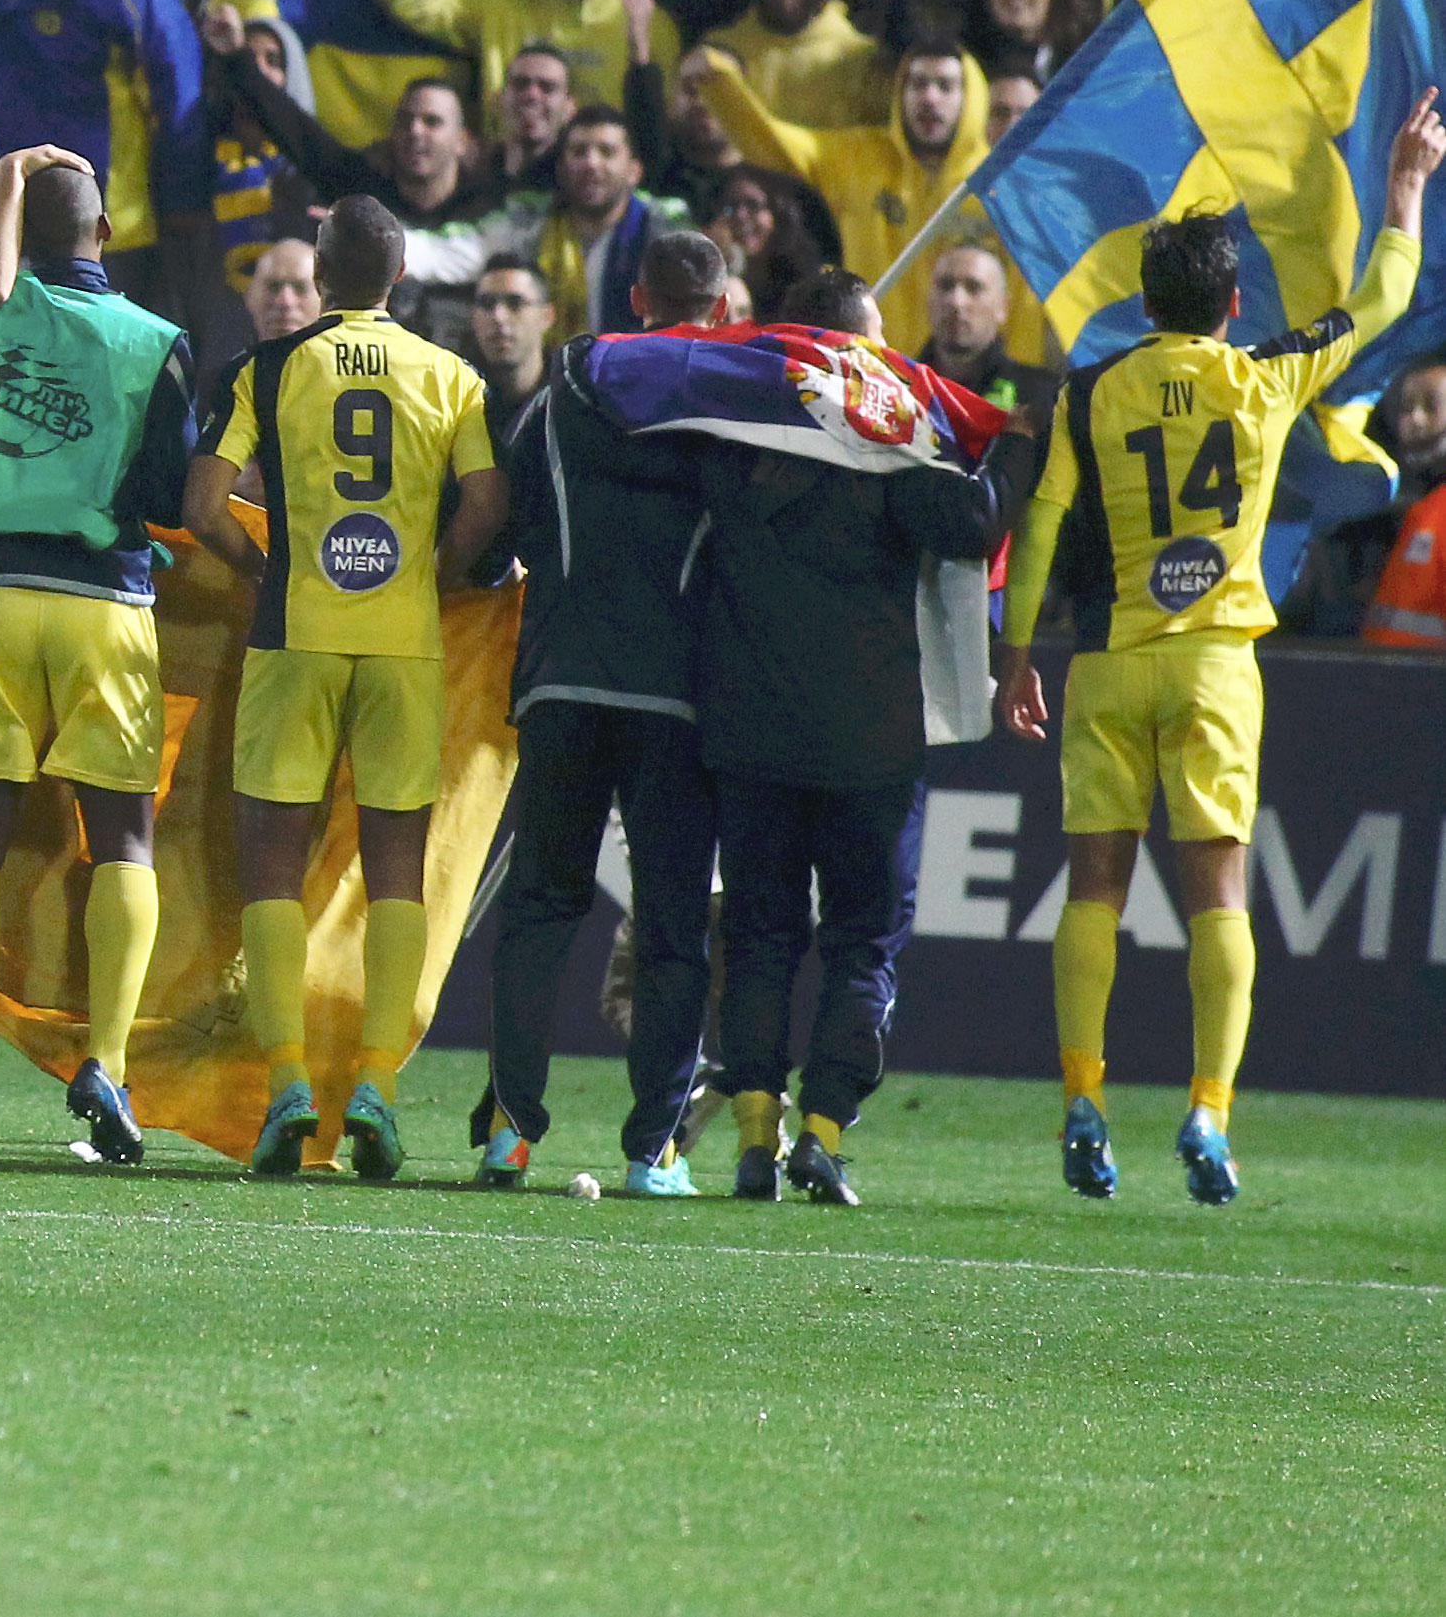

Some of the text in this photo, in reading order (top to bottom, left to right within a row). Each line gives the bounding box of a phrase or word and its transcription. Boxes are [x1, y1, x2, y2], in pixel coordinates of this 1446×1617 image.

[336, 343, 389, 376] RADI
[1160, 381, 1193, 417] ZIV
[333, 388, 393, 502] 9
[1124, 419, 1243, 539] 14
[330, 537, 393, 555] NIVEA
[335, 555, 386, 572] MEN
[1160, 558, 1220, 576] NIVEA
[1161, 575, 1213, 593] MEN
